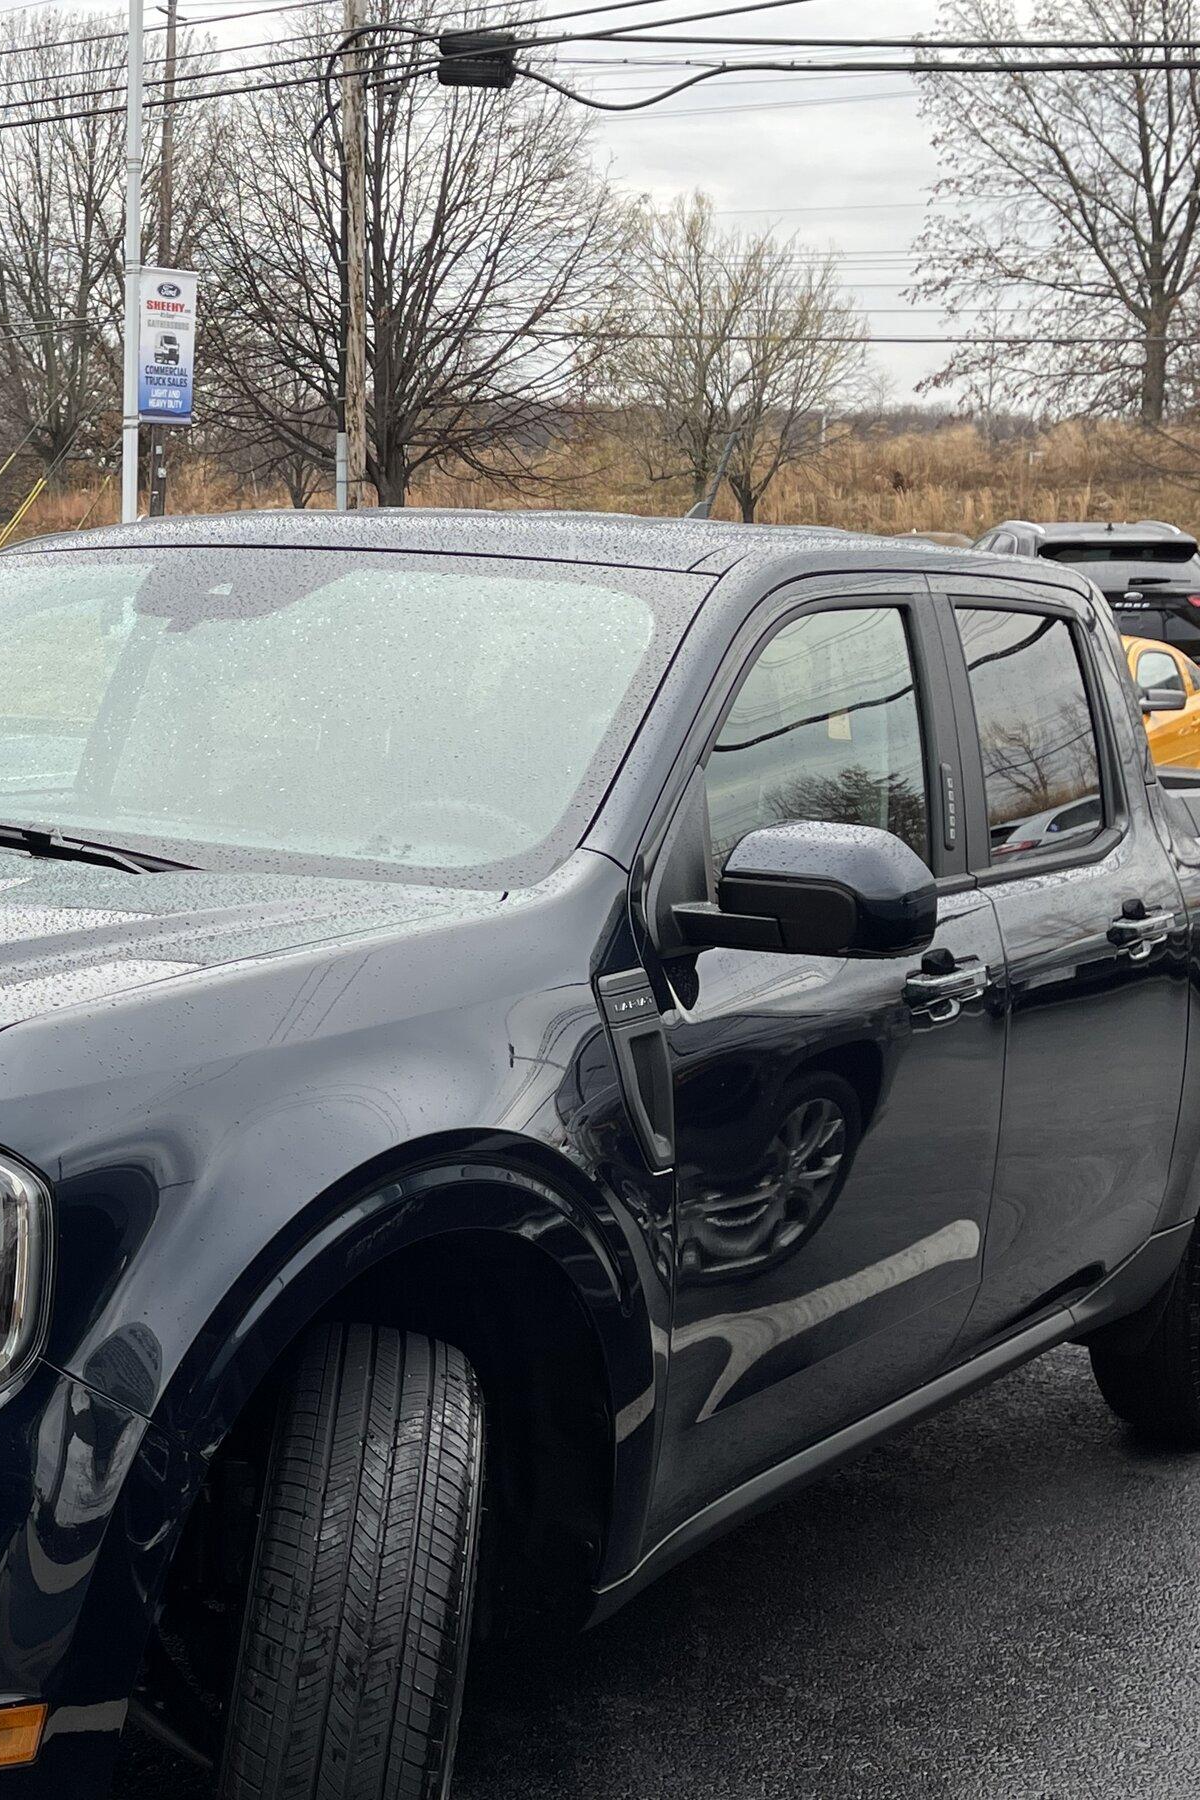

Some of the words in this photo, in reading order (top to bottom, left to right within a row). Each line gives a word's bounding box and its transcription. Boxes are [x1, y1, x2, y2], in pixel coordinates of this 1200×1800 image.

[146, 300, 185, 313] SHEEHY
[145, 365, 188, 377] COMMERCIAL
[145, 376, 166, 386] TRUCK
[167, 377, 188, 387] SALES
[151, 388, 167, 398] LIGHT
[167, 389, 181, 399] AND
[148, 399, 167, 408] HEAVY
[167, 399, 183, 409] DUTY
